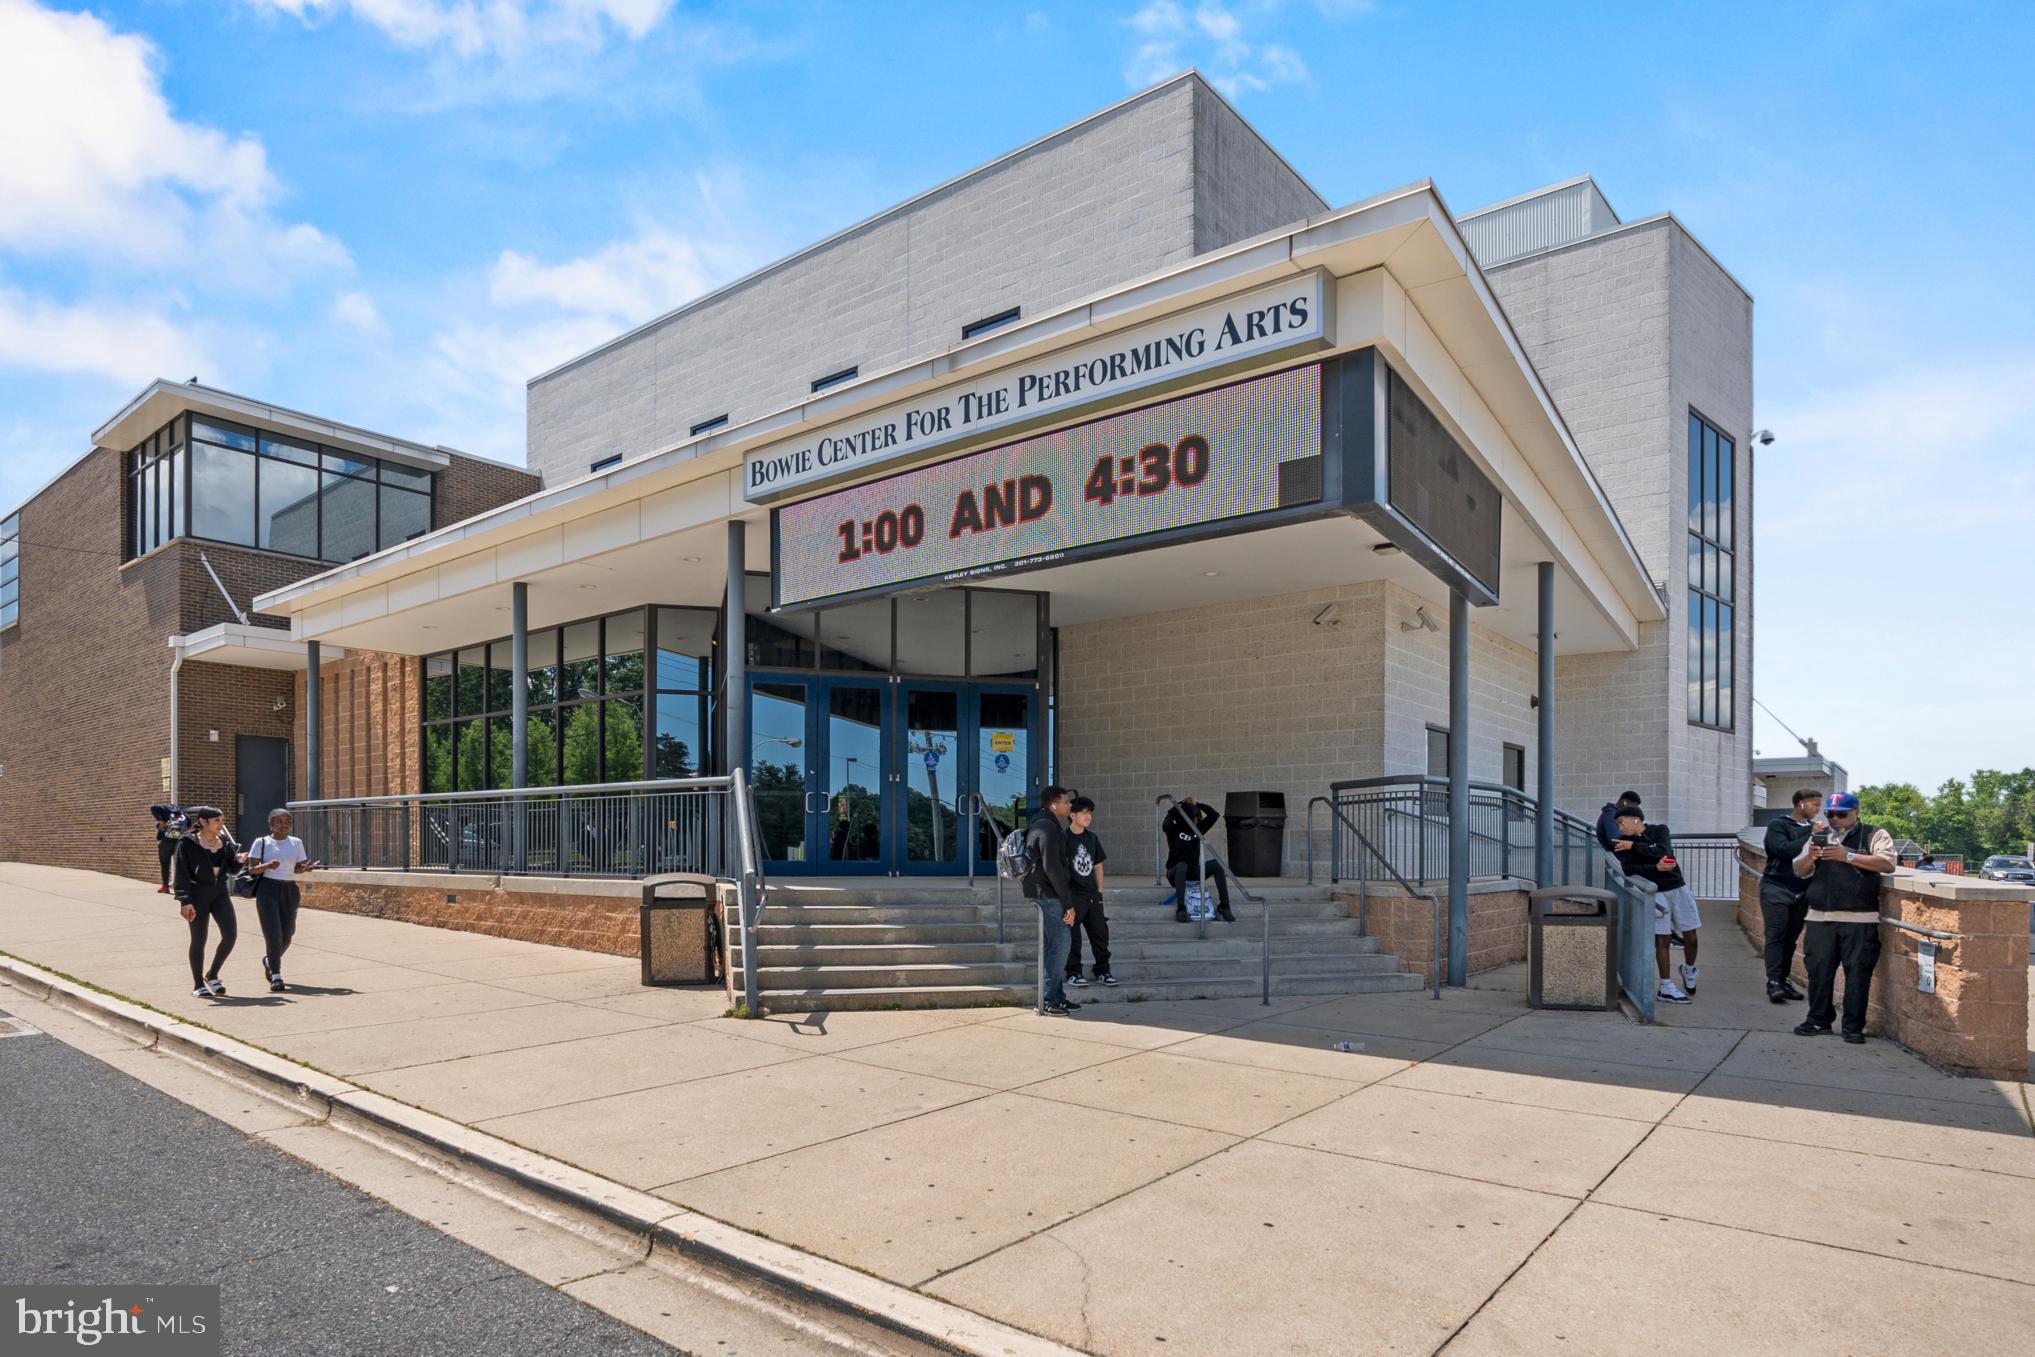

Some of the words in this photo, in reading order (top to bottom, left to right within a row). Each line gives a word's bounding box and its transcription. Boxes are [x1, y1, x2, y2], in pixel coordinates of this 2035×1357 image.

[838, 502, 925, 564] 1:00
[949, 473, 1053, 539] AND
[1084, 434, 1210, 506] 4:30
[944, 571, 968, 580] KERLEY
